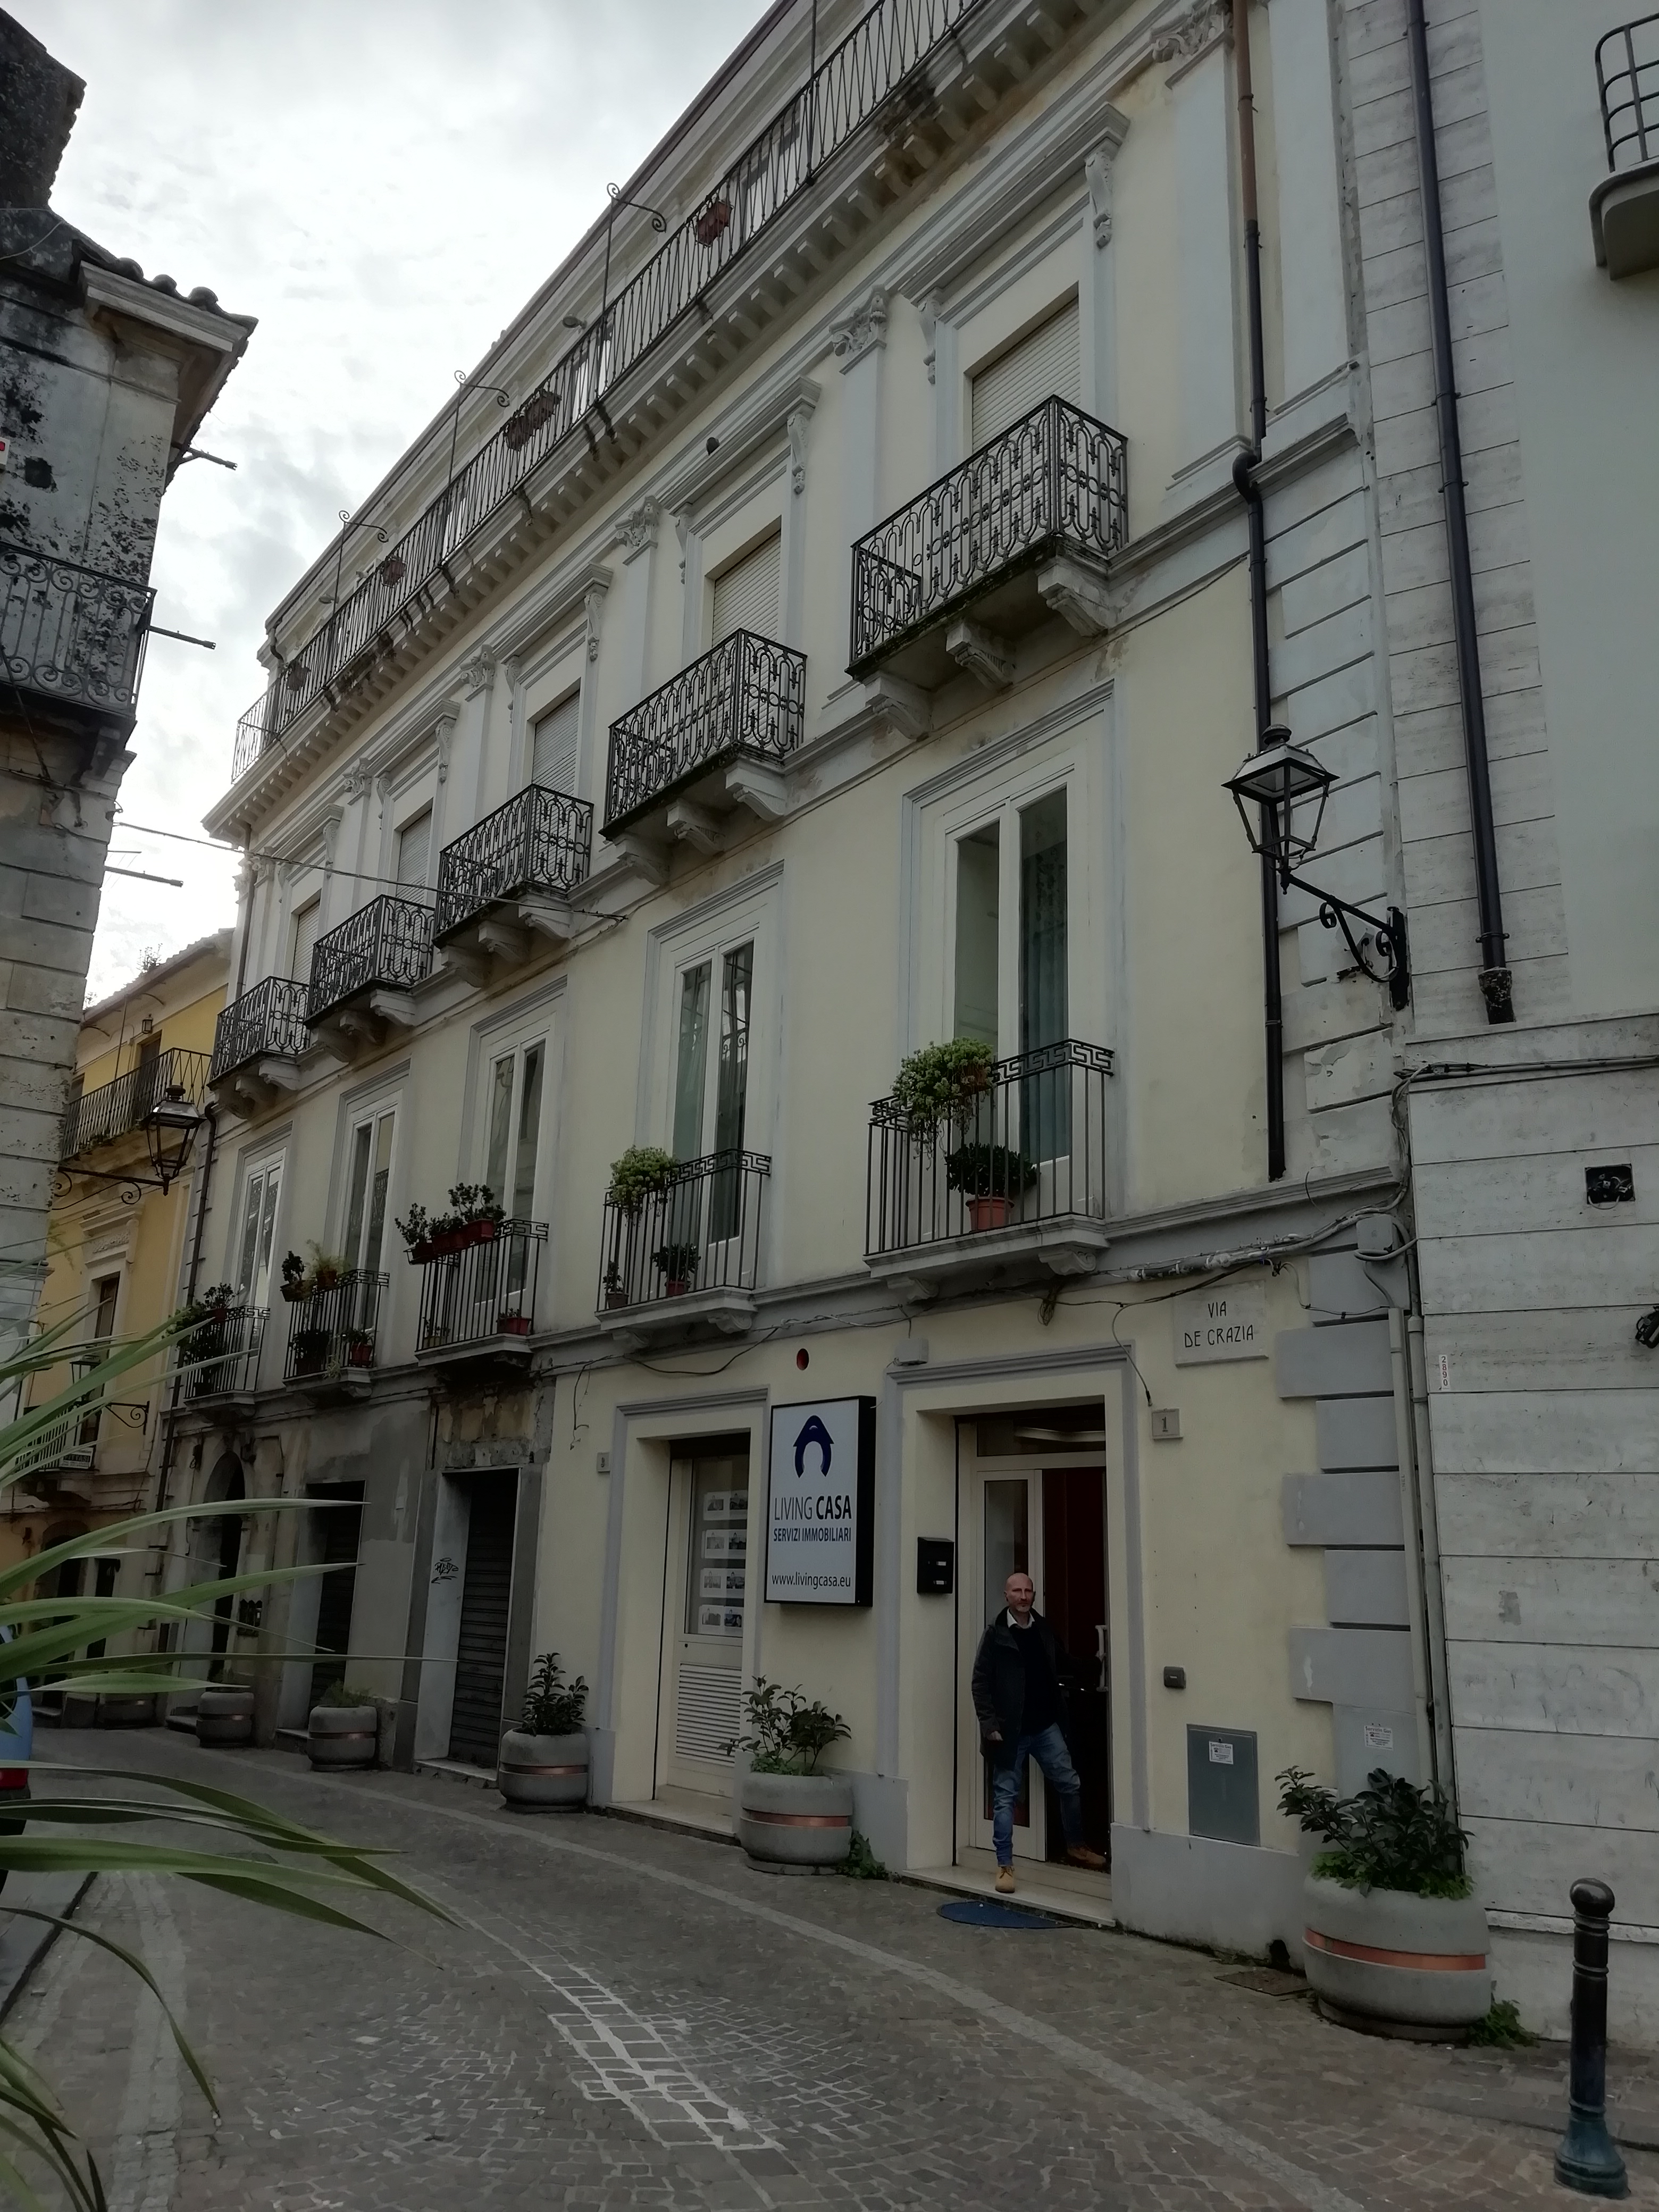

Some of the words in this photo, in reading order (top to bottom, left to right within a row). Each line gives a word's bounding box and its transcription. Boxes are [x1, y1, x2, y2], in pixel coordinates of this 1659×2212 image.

[1207, 1301, 1227, 1318] VIA
[1184, 1331, 1201, 1348] DE
[1161, 1416, 1168, 1432] 1
[774, 1496, 813, 1521] LIVING
[816, 1495, 852, 1520] CASA
[773, 1527, 801, 1542] SERVIZI
[802, 1527, 851, 1542] IMMOBILIARI
[772, 1572, 851, 1590] www.livingcasa.eu
